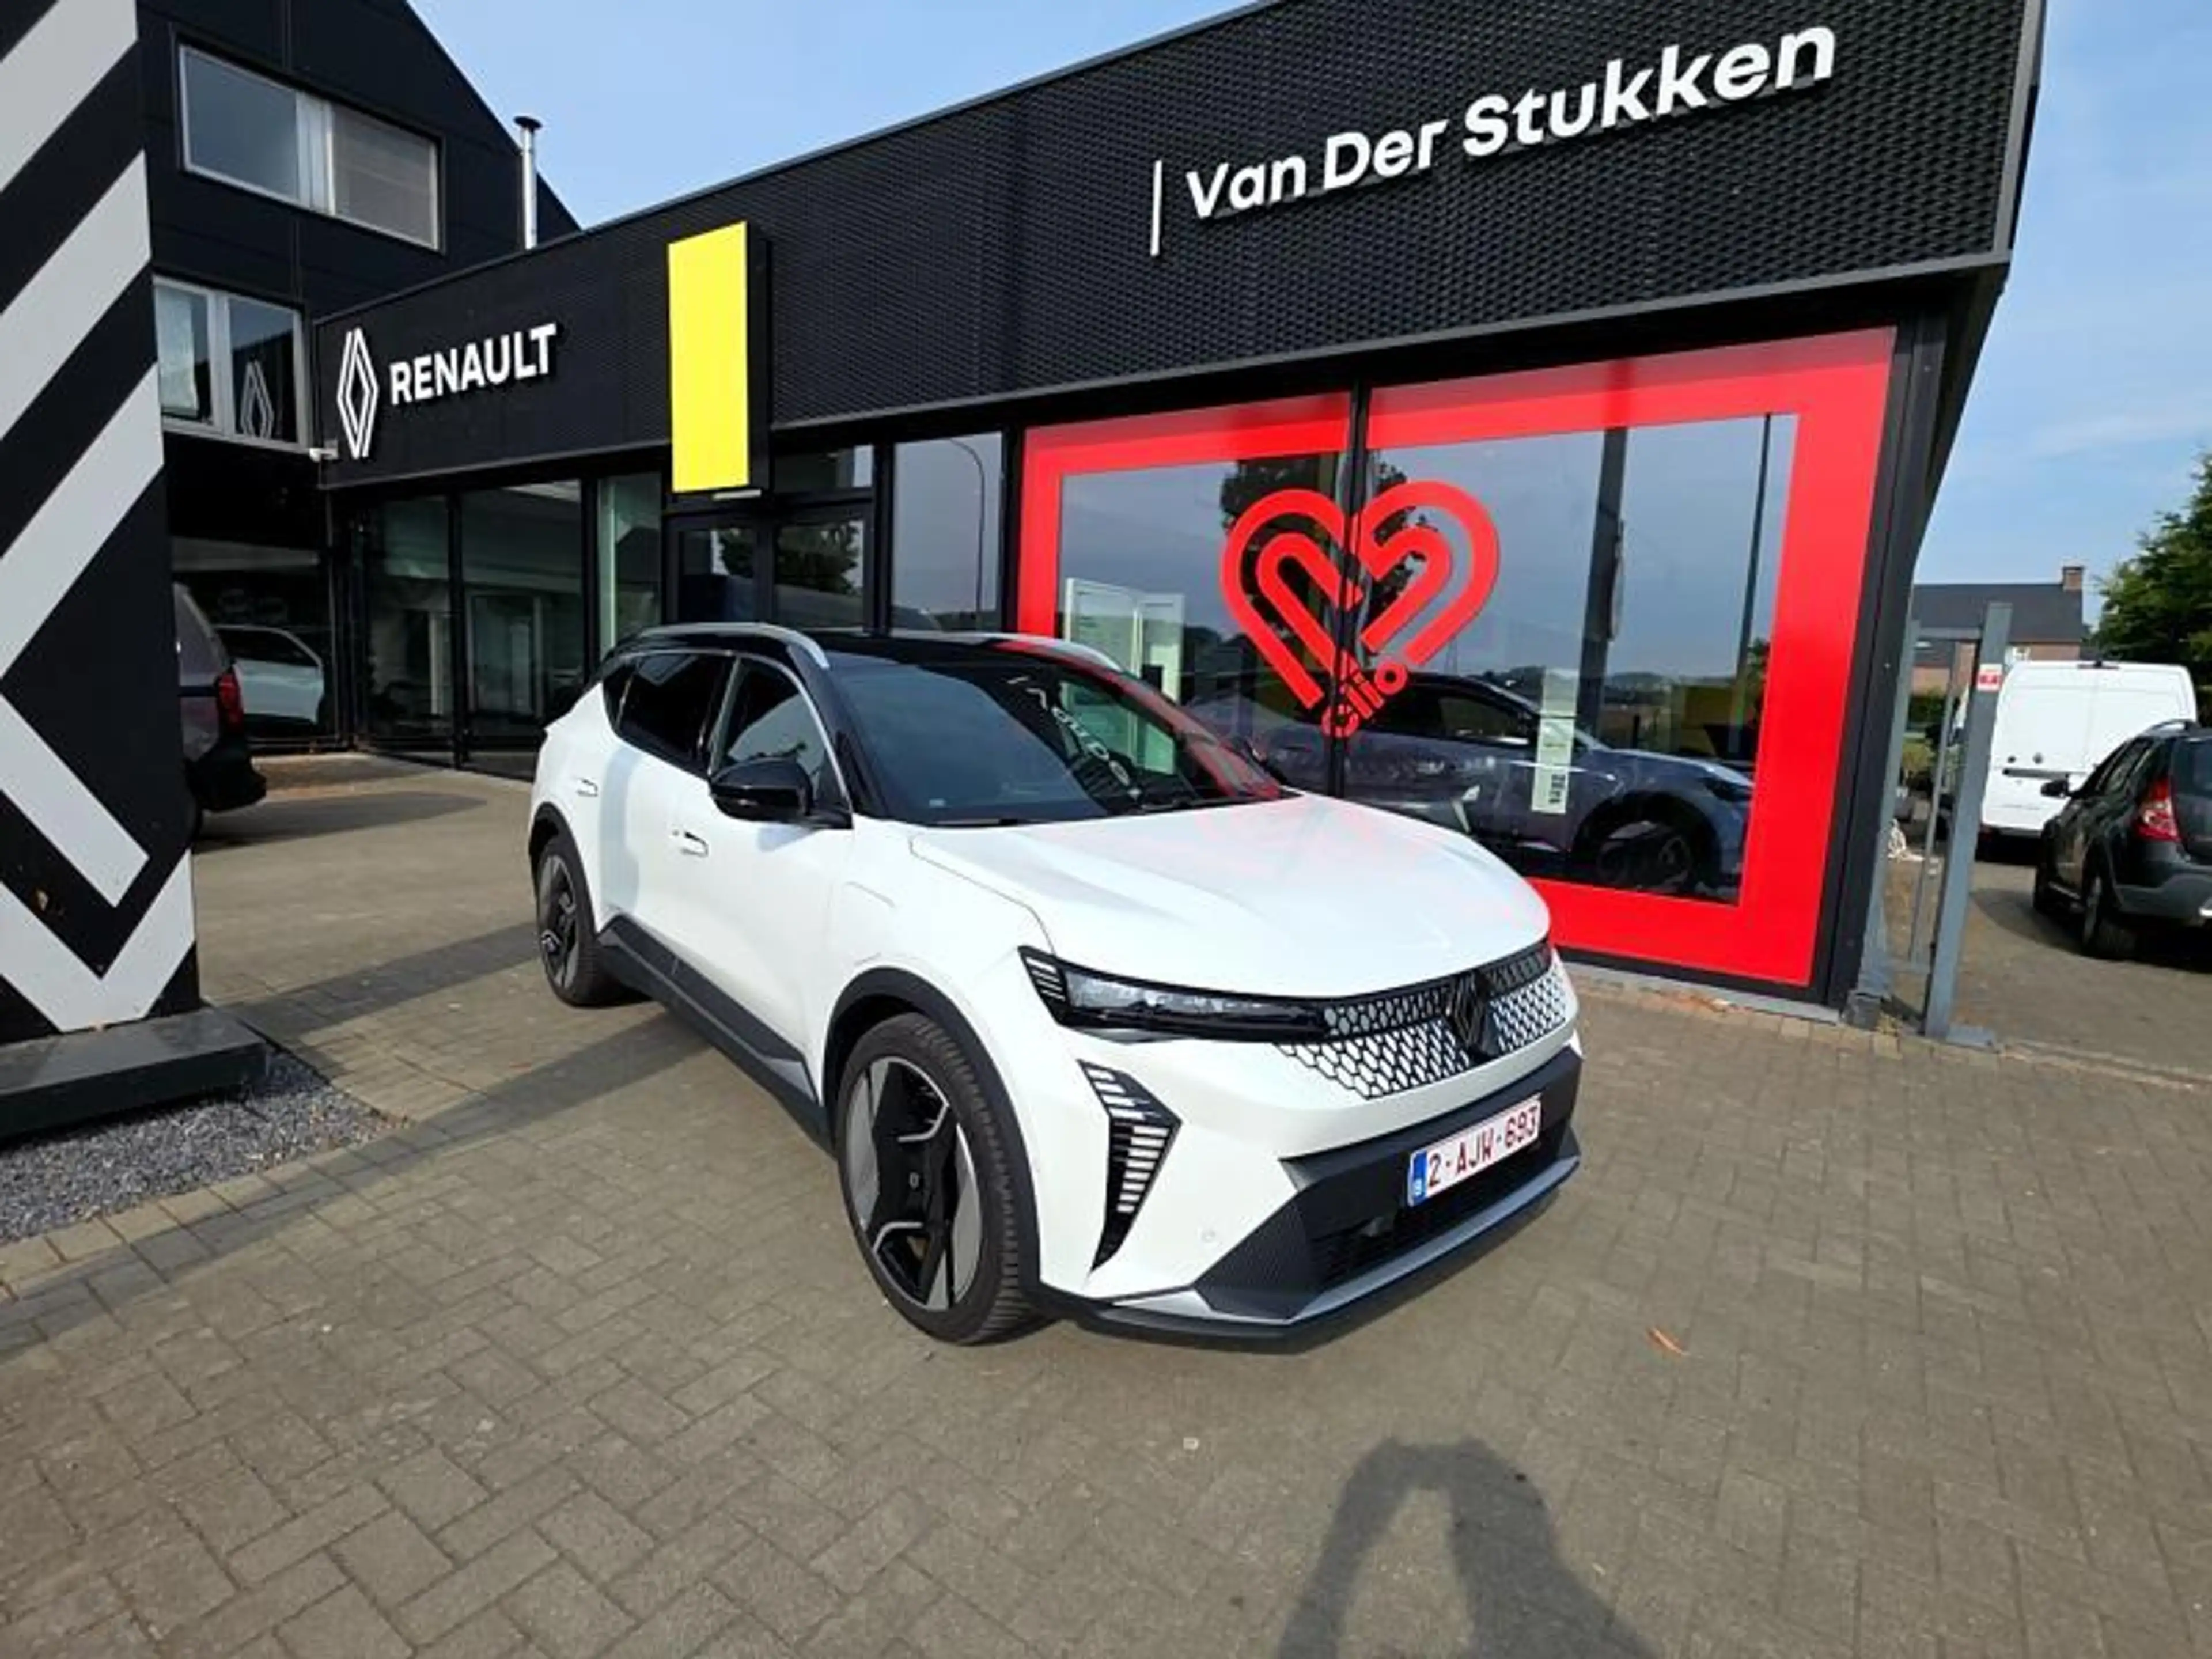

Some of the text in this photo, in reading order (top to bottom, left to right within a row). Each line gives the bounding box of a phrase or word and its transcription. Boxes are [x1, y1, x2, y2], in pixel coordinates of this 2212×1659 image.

[1186, 25, 1836, 219] Van Der Stukken
[390, 323, 557, 405] RENAULT
